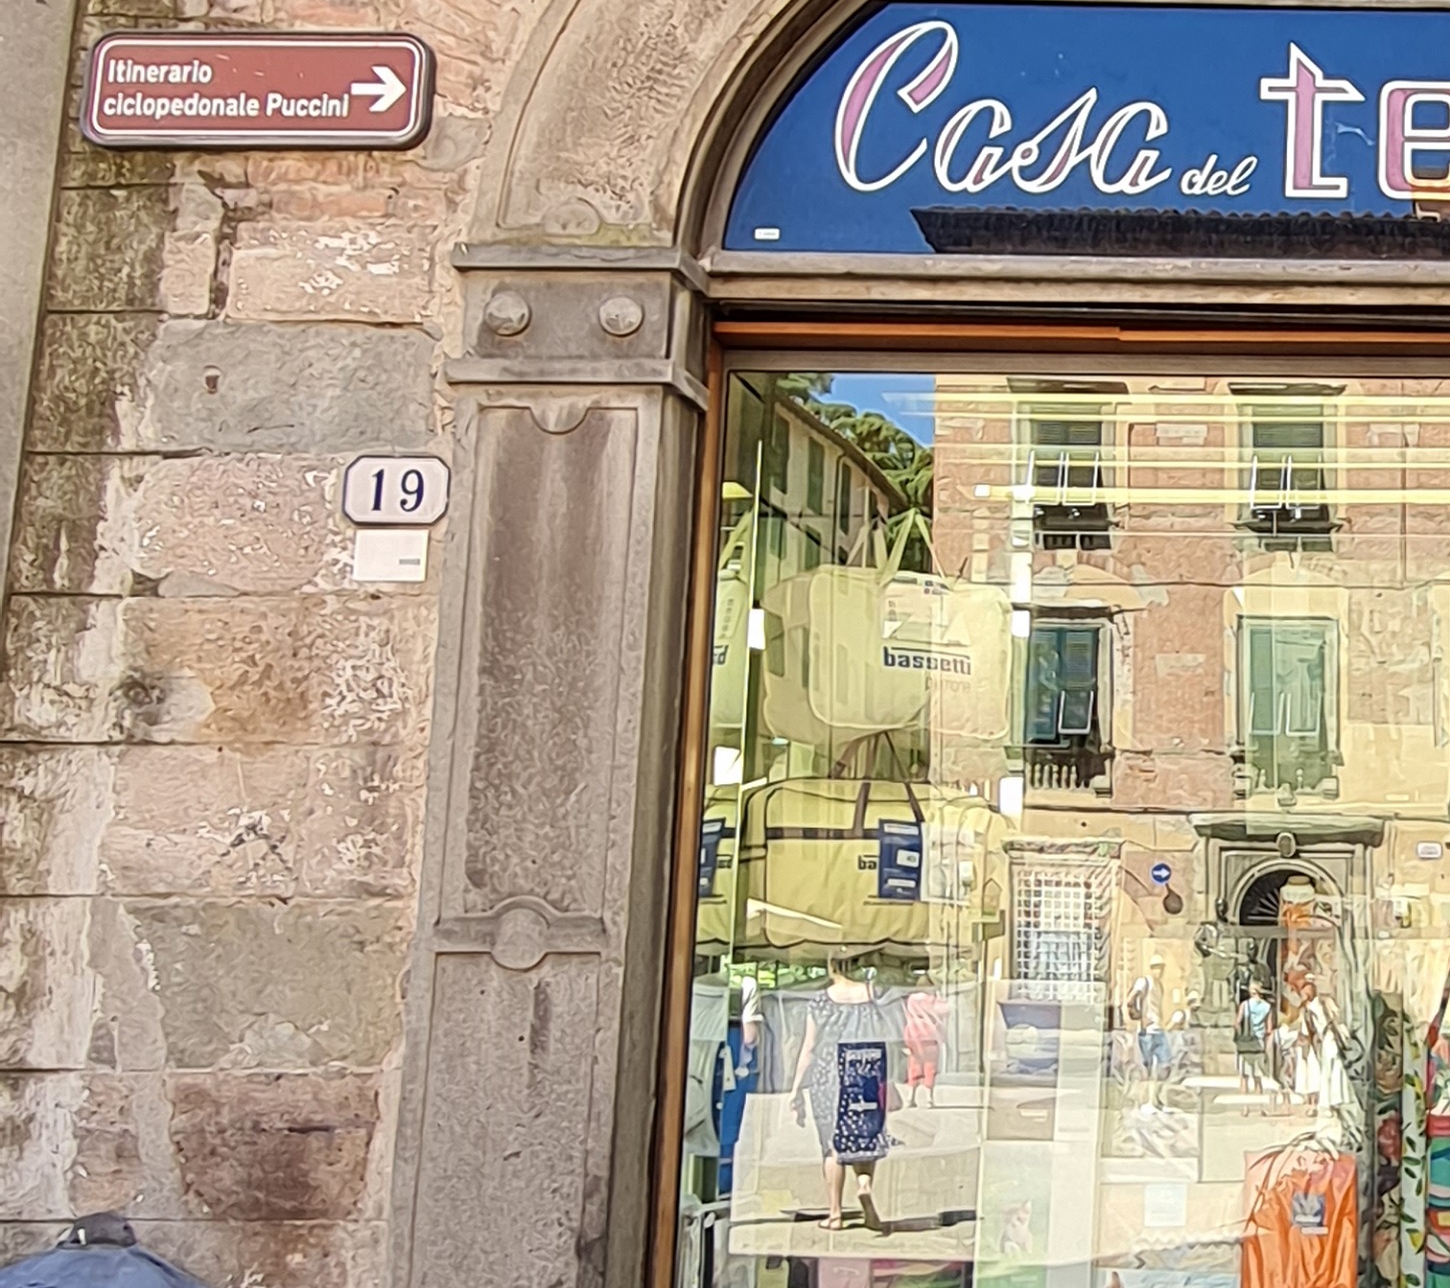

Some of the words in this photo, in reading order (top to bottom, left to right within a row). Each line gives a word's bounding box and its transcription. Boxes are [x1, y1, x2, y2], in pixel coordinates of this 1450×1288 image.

[106, 58, 213, 84] Itinerario
[102, 91, 261, 121] ciclopedonale
[265, 92, 350, 119] Puccini
[834, 19, 1173, 195] Casa
[1180, 154, 1258, 196] del
[371, 467, 425, 513] 19
[882, 645, 972, 677] bassetti
